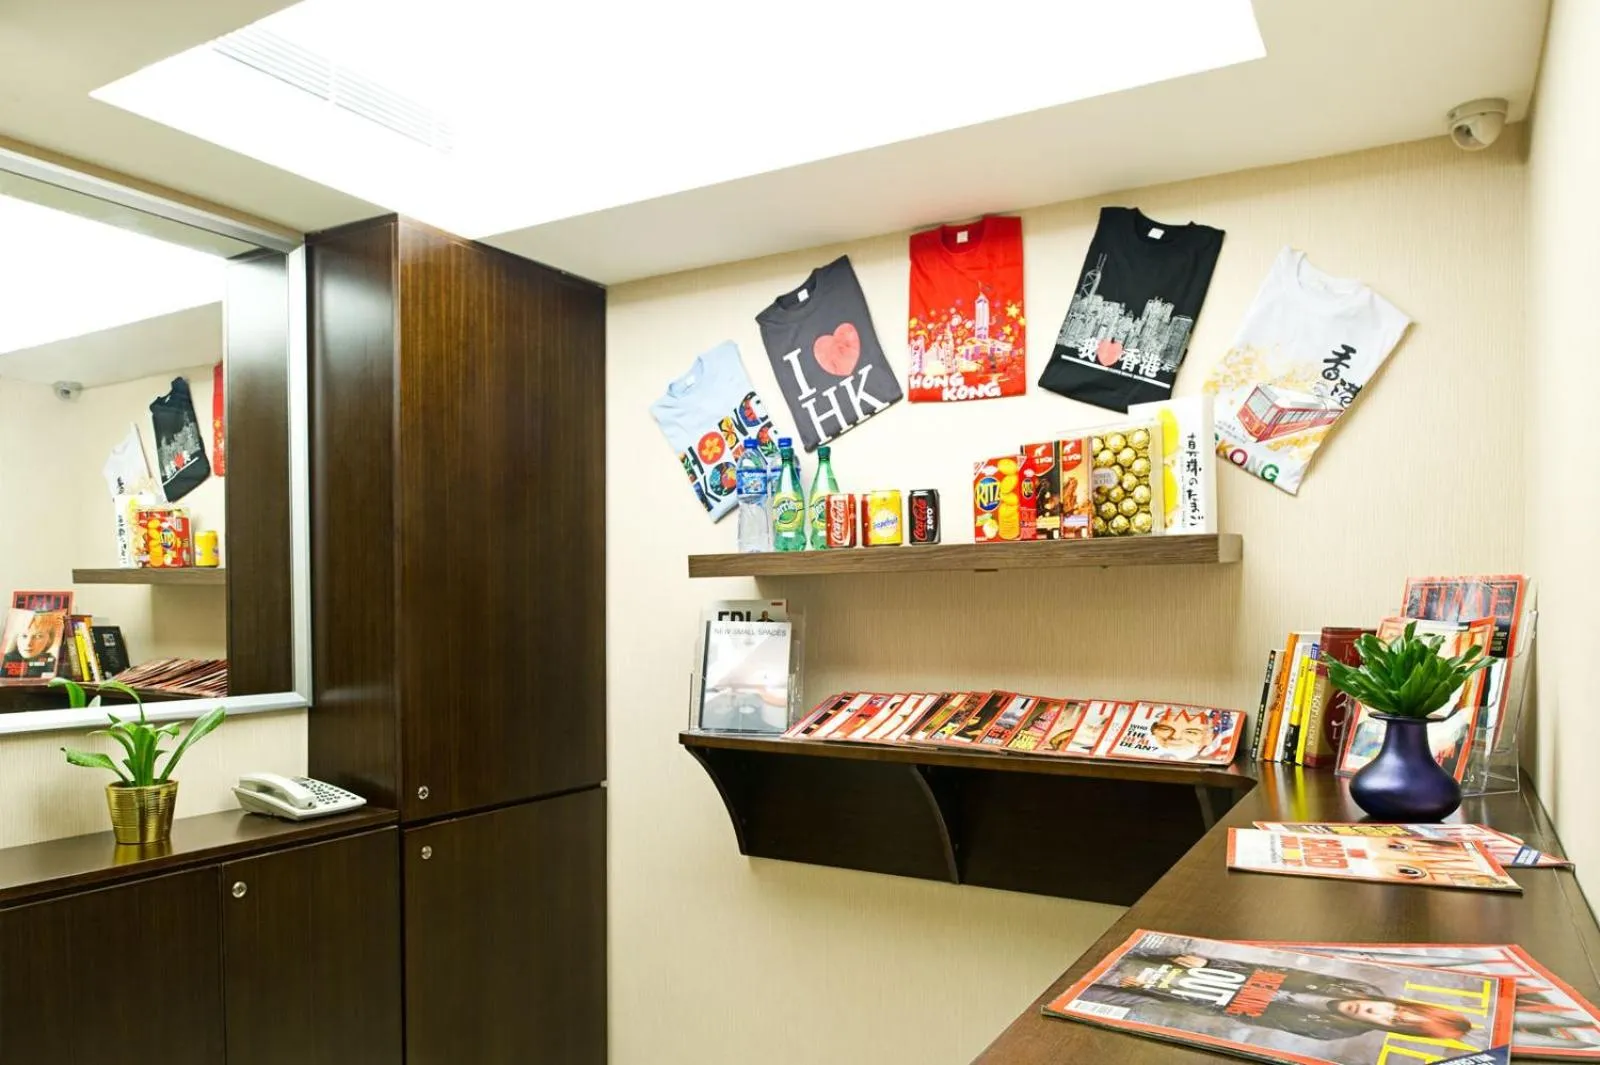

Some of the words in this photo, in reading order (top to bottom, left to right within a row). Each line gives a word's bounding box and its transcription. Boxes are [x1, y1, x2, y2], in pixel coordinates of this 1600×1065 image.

[783, 348, 817, 401] I
[1121, 348, 1161, 378] 香港
[1322, 344, 1363, 407] 香港
[909, 372, 965, 390] HONG
[942, 381, 1001, 401] KONG
[801, 364, 890, 445] HK
[1216, 440, 1280, 484] KONG
[976, 481, 1001, 506] RITZ
[926, 507, 934, 530] zero
[1410, 584, 1516, 619] TIME
[757, 629, 787, 637] SPACES
[1119, 741, 1159, 752] DEAN?
[1126, 730, 1147, 739] THE
[1170, 967, 1247, 1007] OUT
[1377, 979, 1492, 1065] TIM
